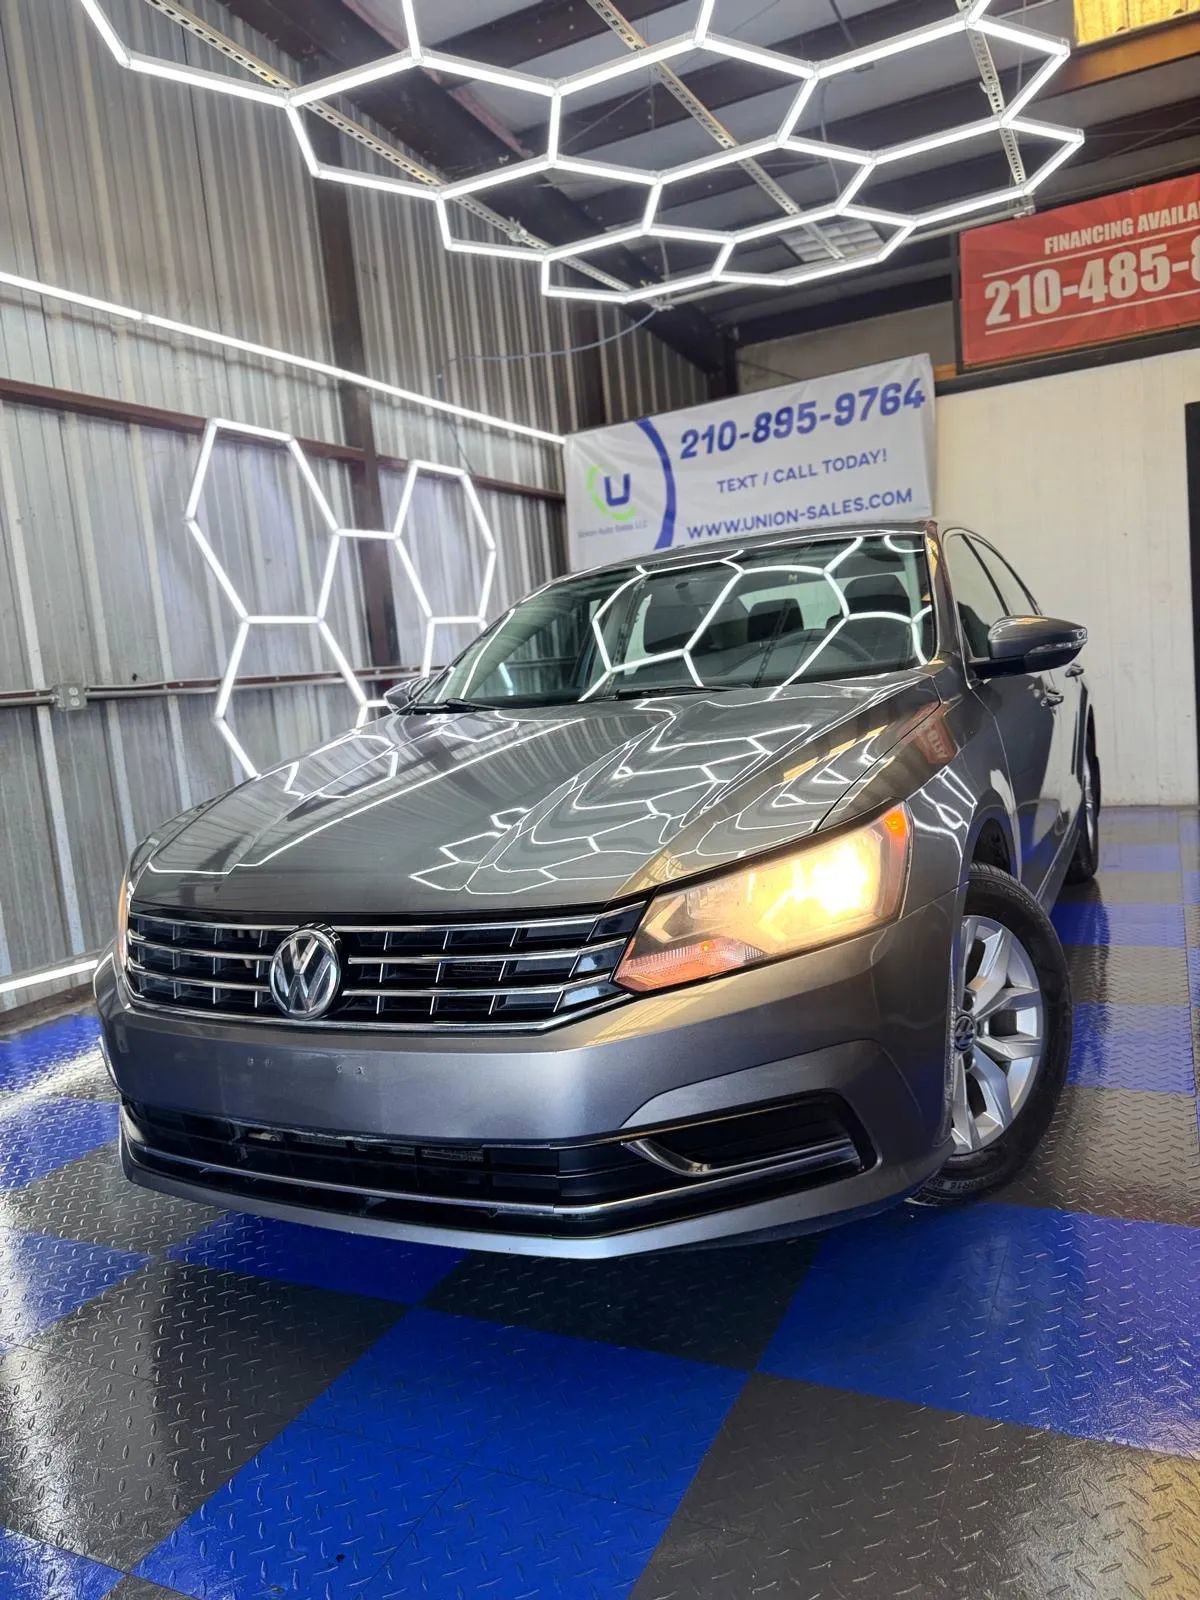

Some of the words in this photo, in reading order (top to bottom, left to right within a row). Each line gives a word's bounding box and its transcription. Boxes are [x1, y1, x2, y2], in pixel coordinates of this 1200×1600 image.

[1044, 217, 1134, 255] FINANCING
[1137, 201, 1200, 233] AVAILA
[679, 378, 926, 460] 210-895-9764
[716, 474, 758, 494] TEXT
[762, 471, 769, 487] /
[773, 463, 818, 484] CALL
[822, 447, 888, 475] TODAY!
[686, 487, 913, 540] WWW.UNION-SALES.COM
